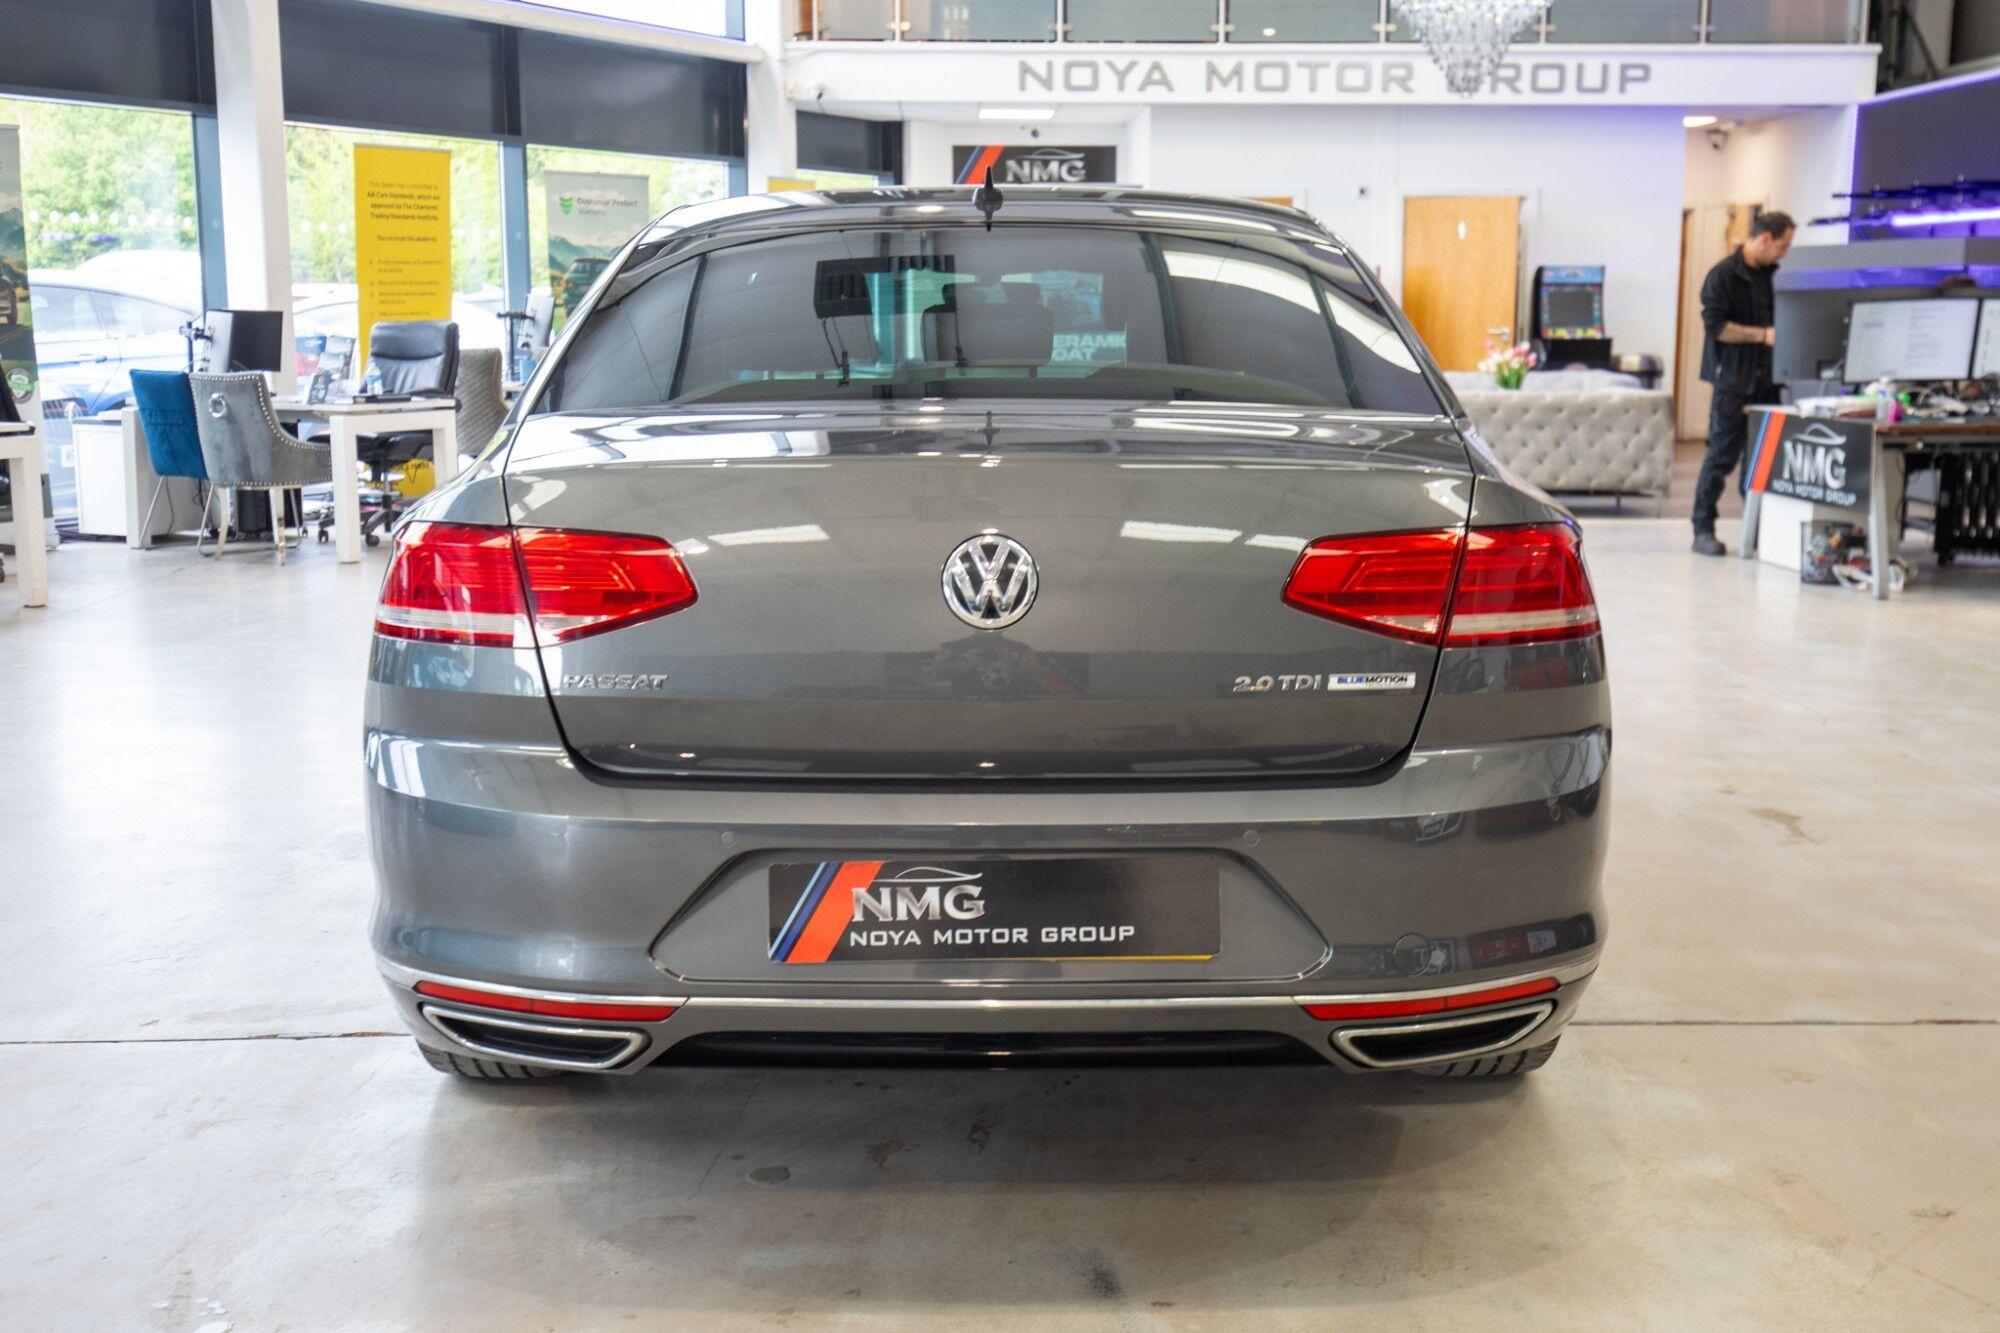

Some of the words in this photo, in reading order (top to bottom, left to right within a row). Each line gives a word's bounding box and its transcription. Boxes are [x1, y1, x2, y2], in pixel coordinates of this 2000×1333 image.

[1018, 59, 1175, 92] NOYA
[1205, 60, 1416, 94] MOTOR
[1005, 159, 1086, 182] NMG
[1782, 439, 1847, 490] NMG
[1795, 482, 1825, 500] MOTOR
[562, 673, 669, 691] PASSAT
[1232, 674, 1275, 694] 2.0
[1277, 673, 1322, 692] TDI
[850, 884, 986, 924] NMG
[849, 926, 922, 948] NOYA
[933, 926, 1029, 945] MOTOR
[1040, 925, 1136, 944] GROUP
